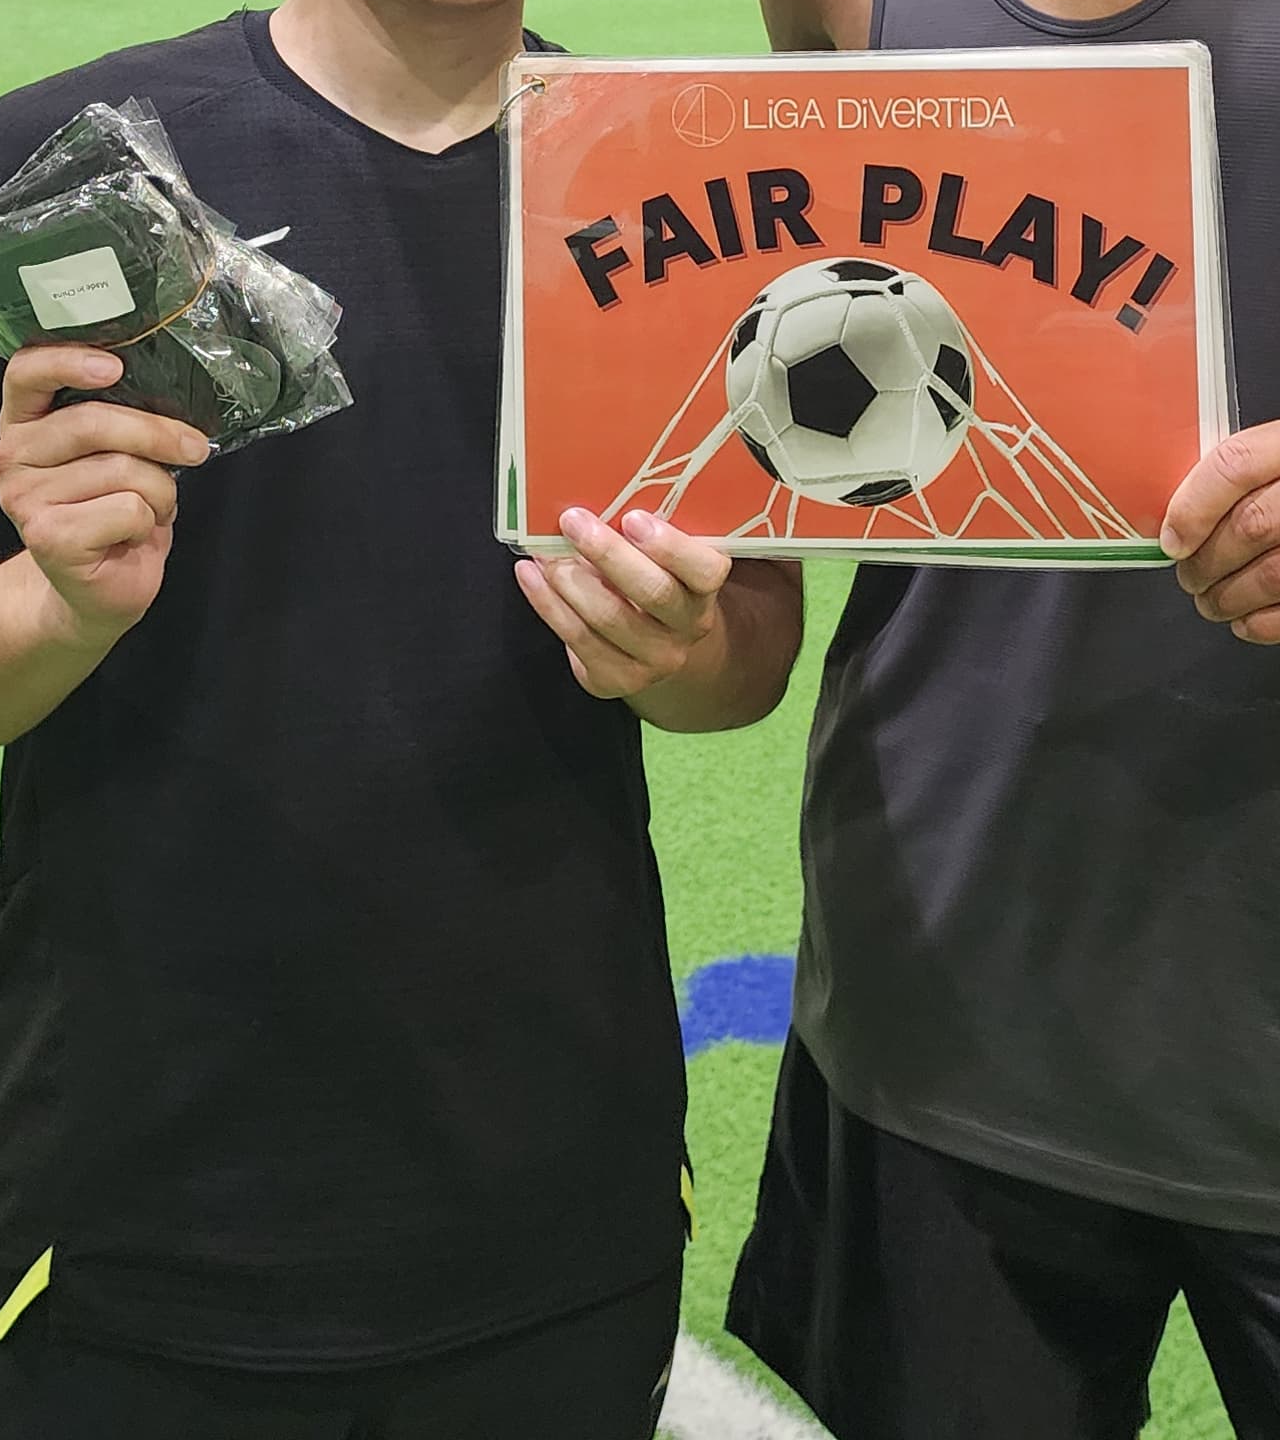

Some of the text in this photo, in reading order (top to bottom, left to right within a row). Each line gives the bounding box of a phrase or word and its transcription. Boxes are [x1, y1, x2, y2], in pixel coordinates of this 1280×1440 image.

[564, 163, 1178, 335] FAIR PLAY!
[86, 281, 109, 291] Made
[52, 288, 76, 300] China
